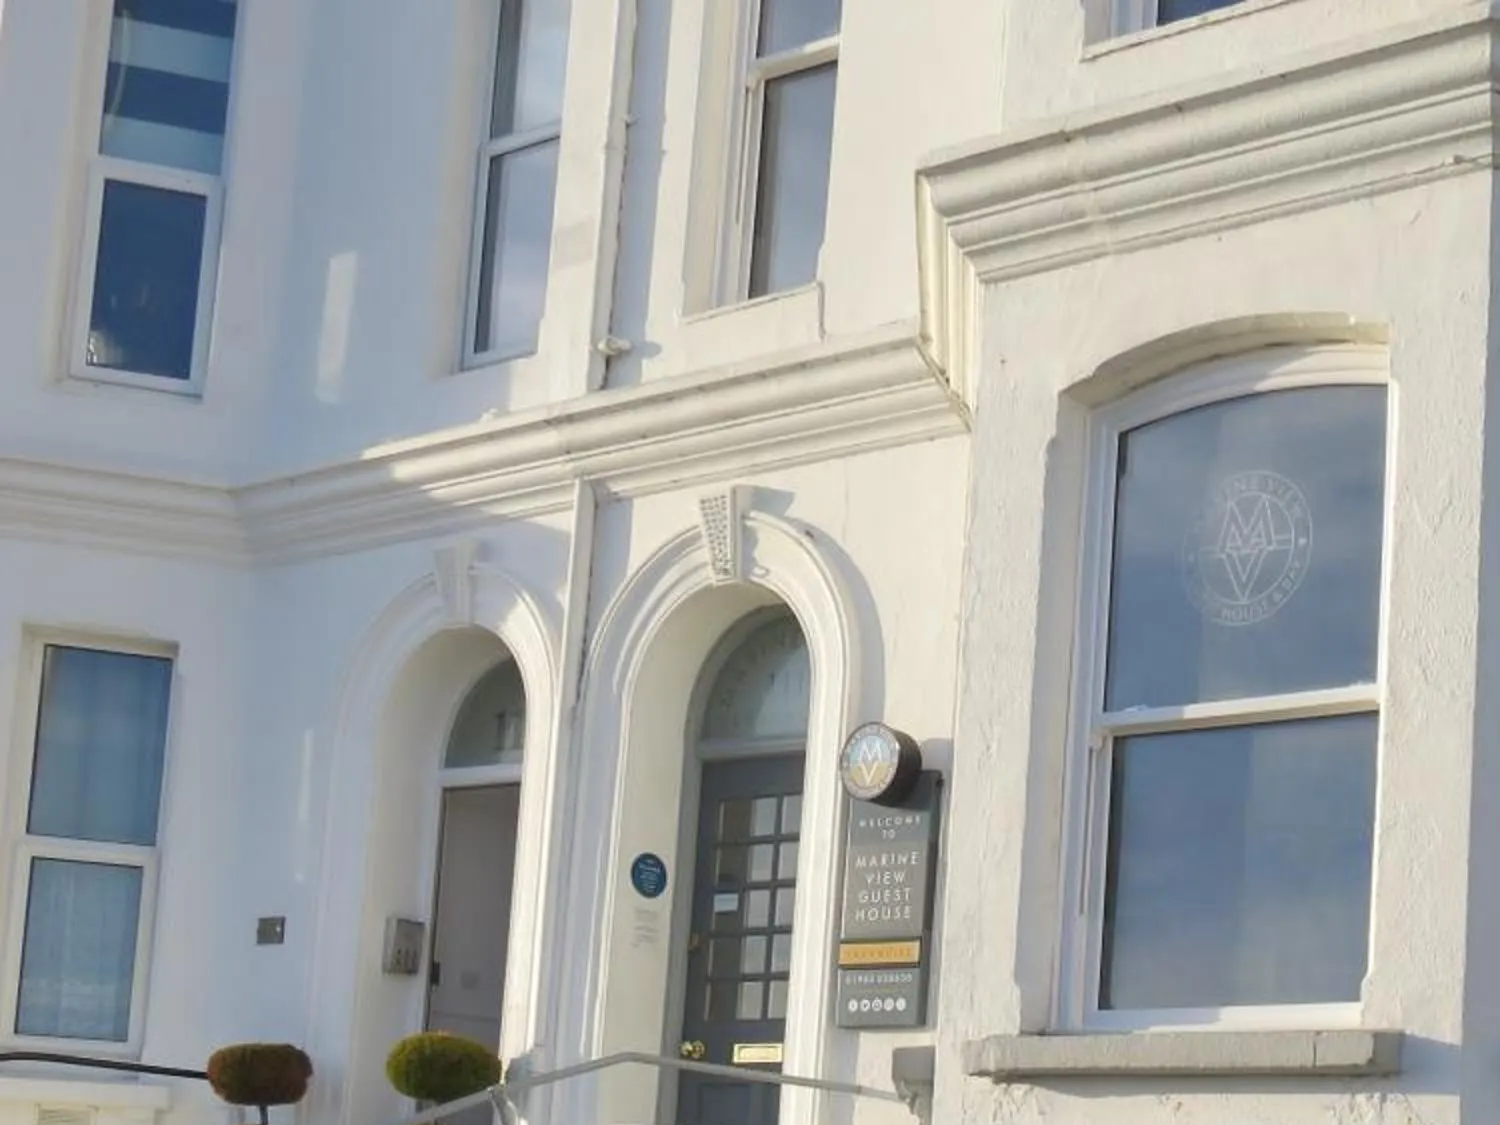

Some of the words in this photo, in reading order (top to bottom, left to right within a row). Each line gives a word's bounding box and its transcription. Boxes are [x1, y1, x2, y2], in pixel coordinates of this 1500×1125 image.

[856, 851, 920, 867] MARINE
[865, 870, 907, 885] VIEW
[859, 887, 911, 903] GUEST
[855, 905, 912, 921] HOUSE
